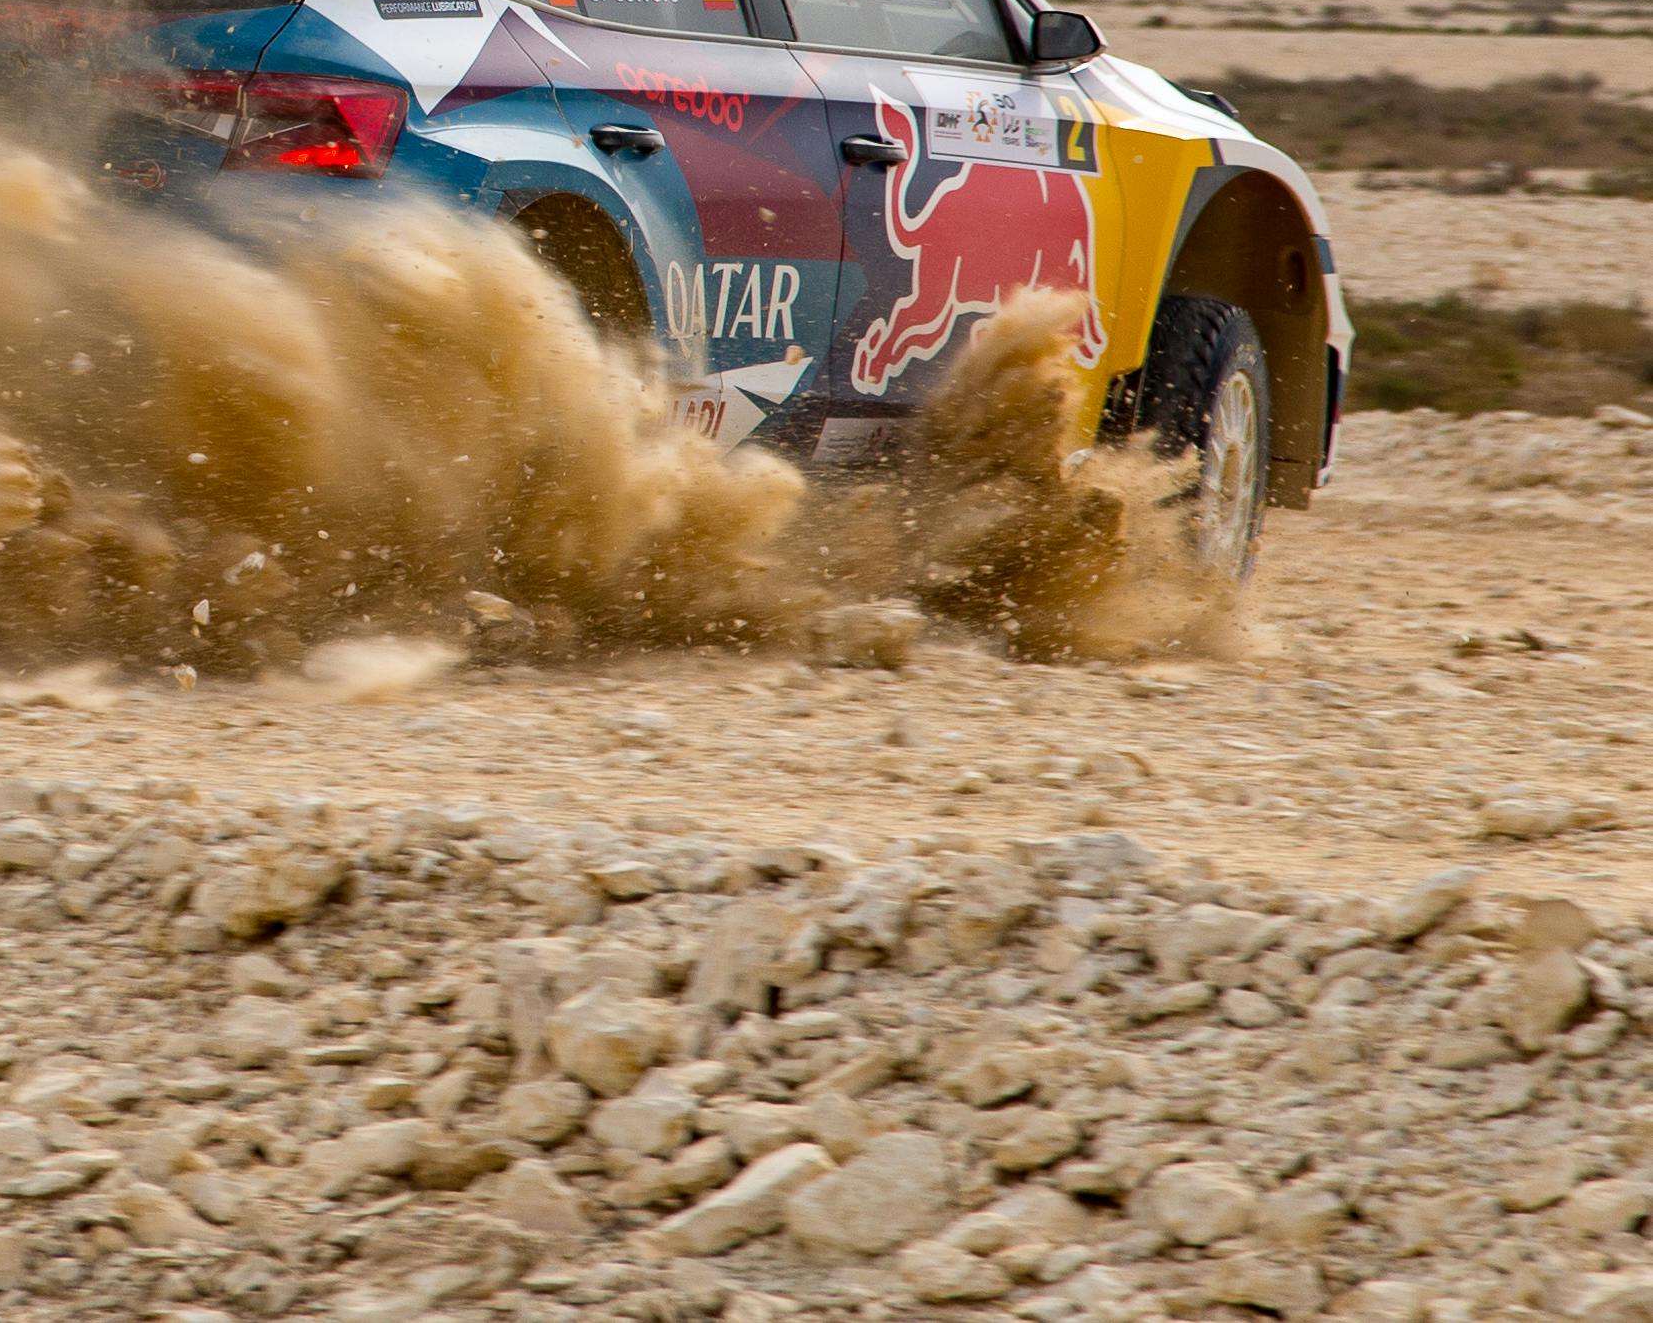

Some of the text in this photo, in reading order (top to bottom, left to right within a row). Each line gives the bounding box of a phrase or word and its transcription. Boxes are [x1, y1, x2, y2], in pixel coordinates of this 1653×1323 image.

[380, 0, 478, 15] PERFORMANCE LUBRICATION
[615, 62, 746, 133] ooredoo
[1058, 95, 1086, 162] 2
[666, 260, 801, 360] QATAR
